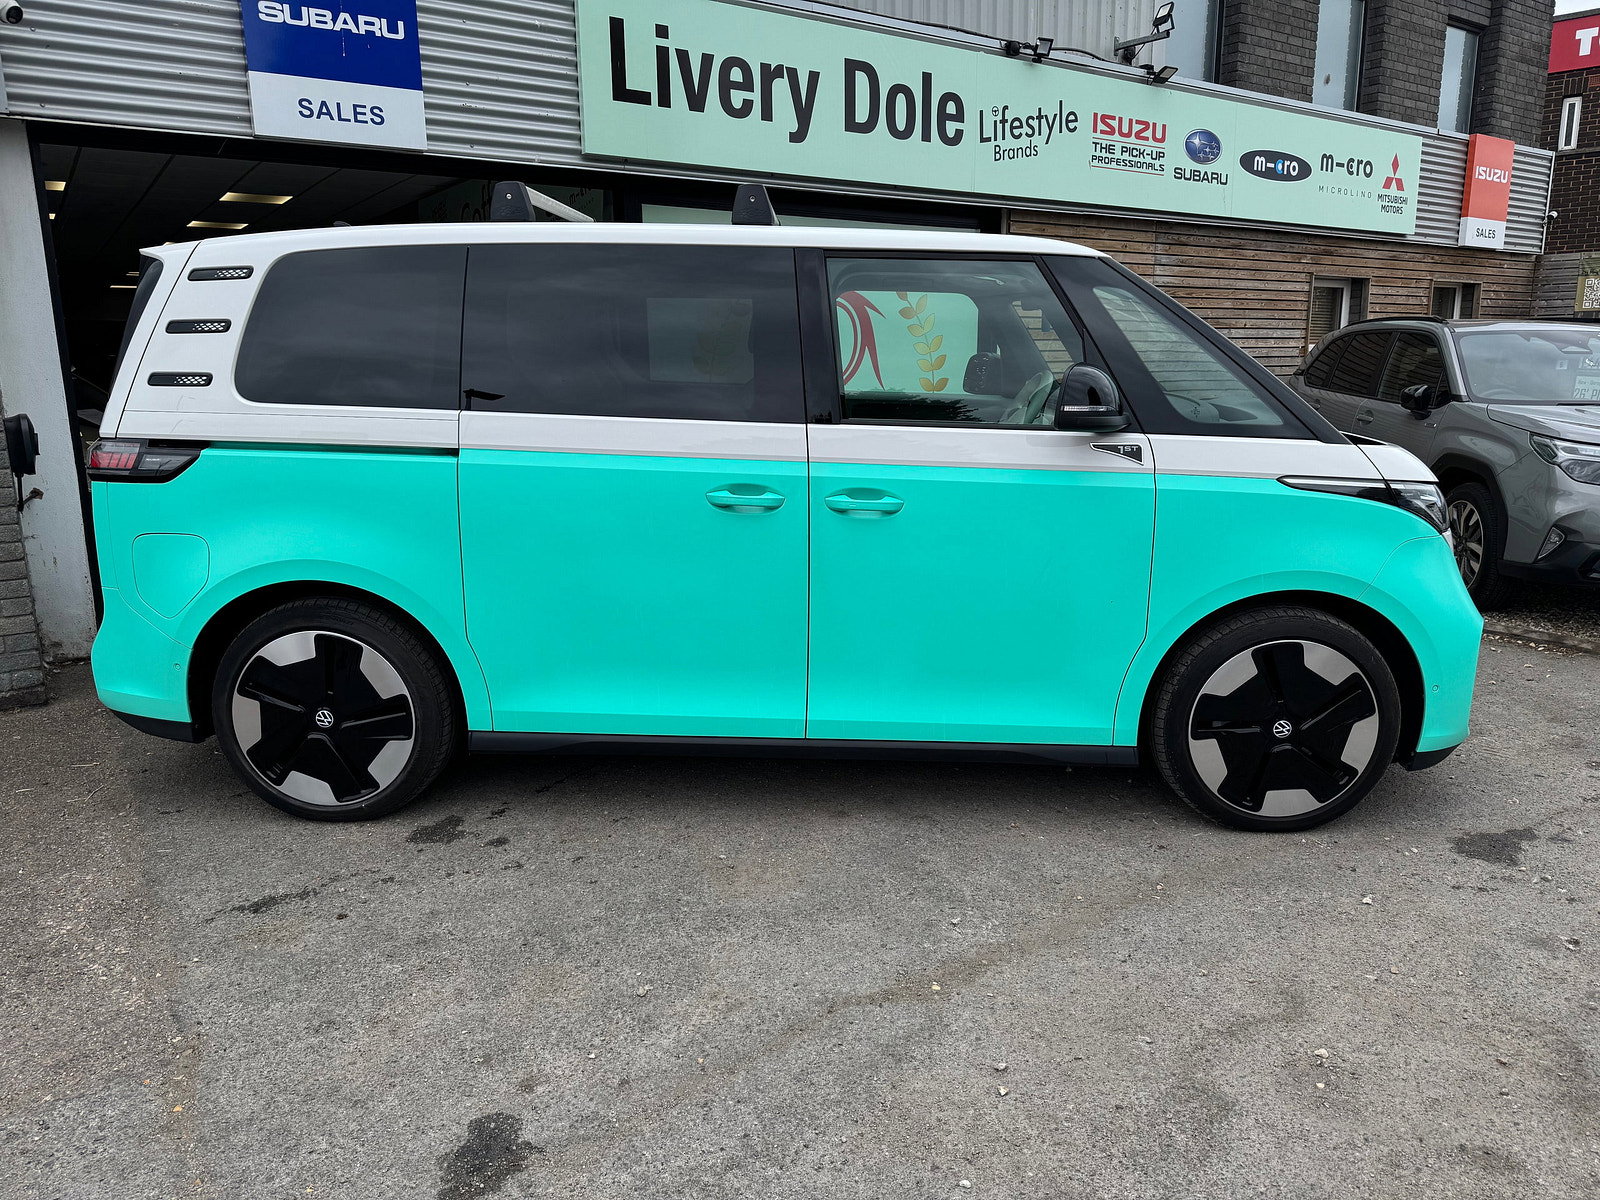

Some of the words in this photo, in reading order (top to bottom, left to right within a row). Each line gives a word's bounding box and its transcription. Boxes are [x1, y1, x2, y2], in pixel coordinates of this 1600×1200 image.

[257, 0, 405, 40] SUBARU
[1575, 26, 1600, 56] T
[609, 16, 821, 143] Livery
[844, 58, 965, 147] Dole
[298, 98, 385, 126] SALES
[979, 99, 1079, 145] Lifestyle
[1092, 112, 1167, 144] ISUZU
[993, 139, 1039, 162] Brands
[1091, 141, 1116, 155] THE
[1120, 145, 1166, 161] PICK-UP
[1091, 154, 1165, 172] PROFESSIONALS
[1173, 166, 1229, 186] SUBARU
[1475, 165, 1509, 184] ISUZU
[1318, 185, 1372, 199] MICROLINO
[1377, 193, 1409, 206] MITSUBISHI
[1380, 204, 1404, 215] MOTORS
[1475, 227, 1497, 240] SALES
[1117, 445, 1139, 454] 1ST
